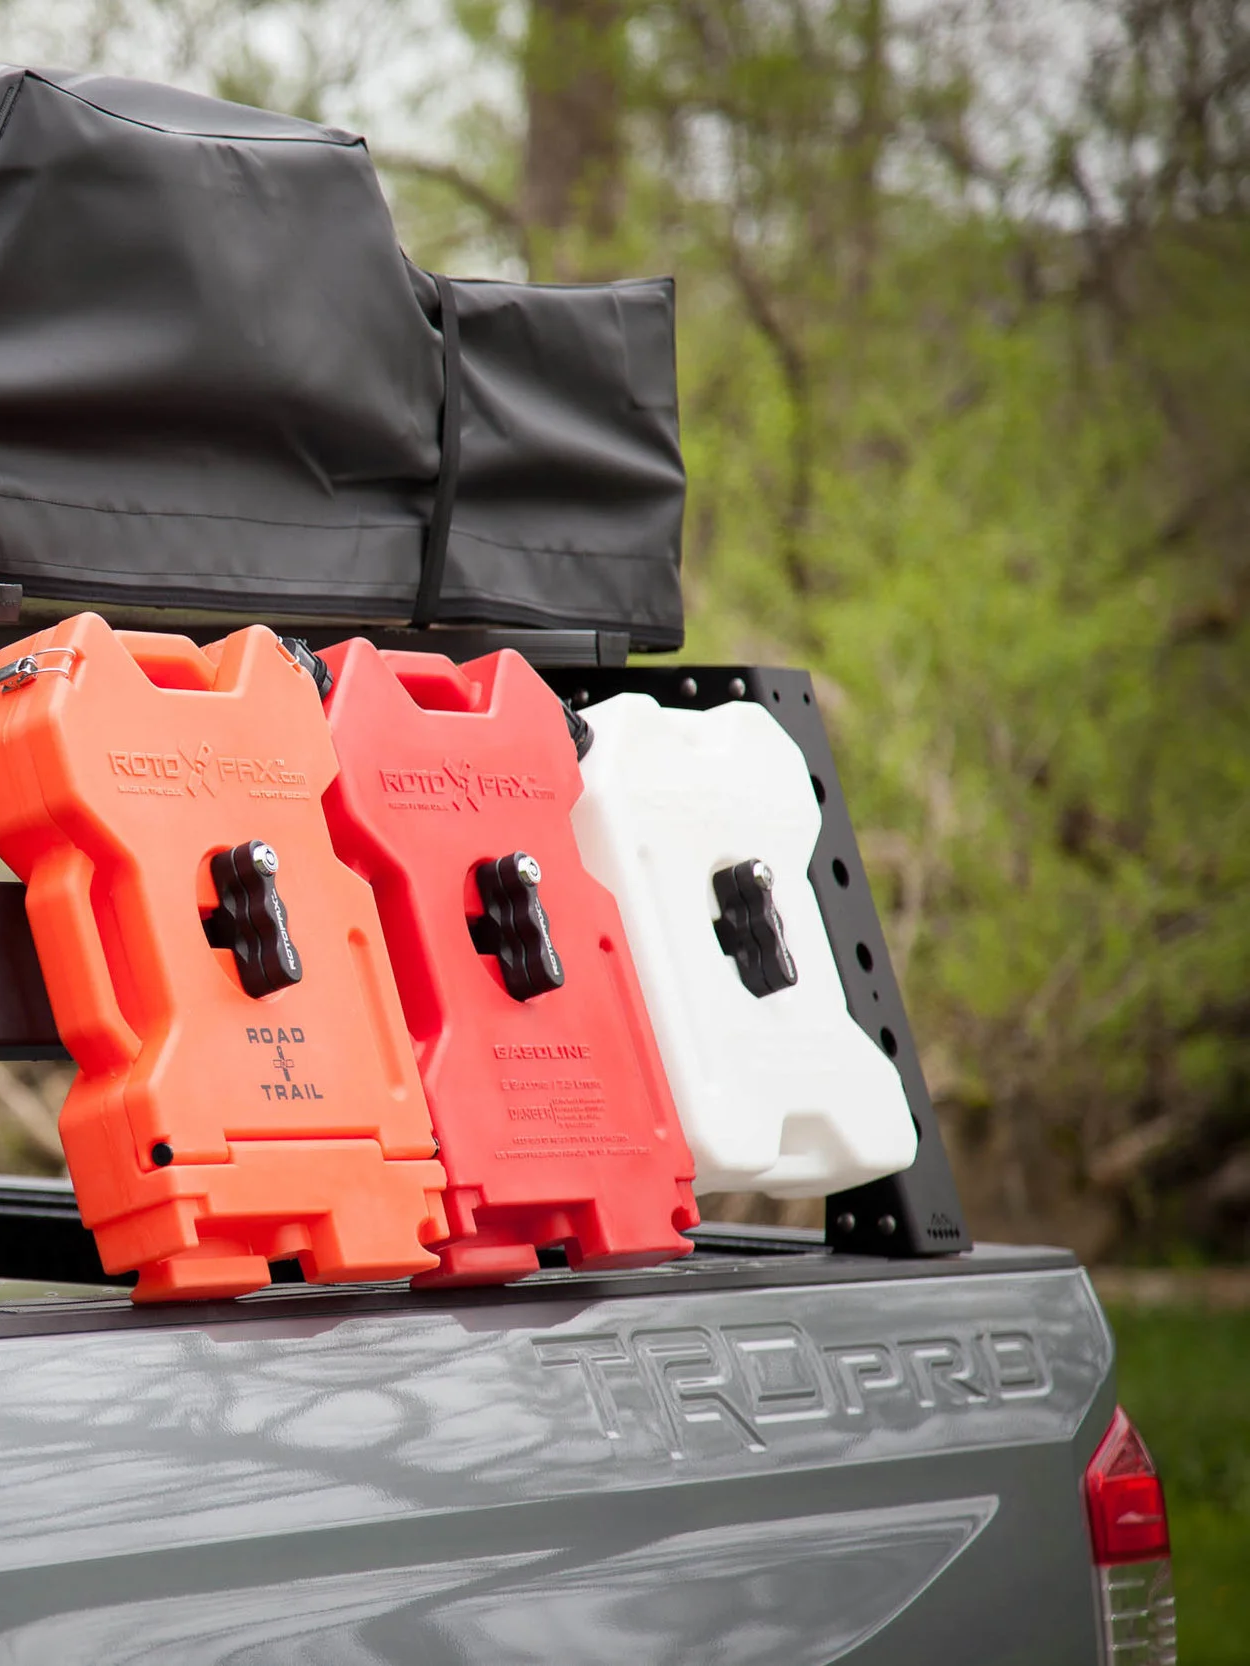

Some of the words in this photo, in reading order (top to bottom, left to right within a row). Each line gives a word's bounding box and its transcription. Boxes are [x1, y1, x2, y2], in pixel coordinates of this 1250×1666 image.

[108, 751, 182, 778] ROTO
[216, 756, 278, 784] PAX
[379, 769, 445, 794] ROTO
[246, 1027, 305, 1044] ROAD
[492, 1043, 592, 1060] GASOLINE
[260, 1083, 324, 1101] TRAIL
[822, 1331, 1054, 1415] PRO
